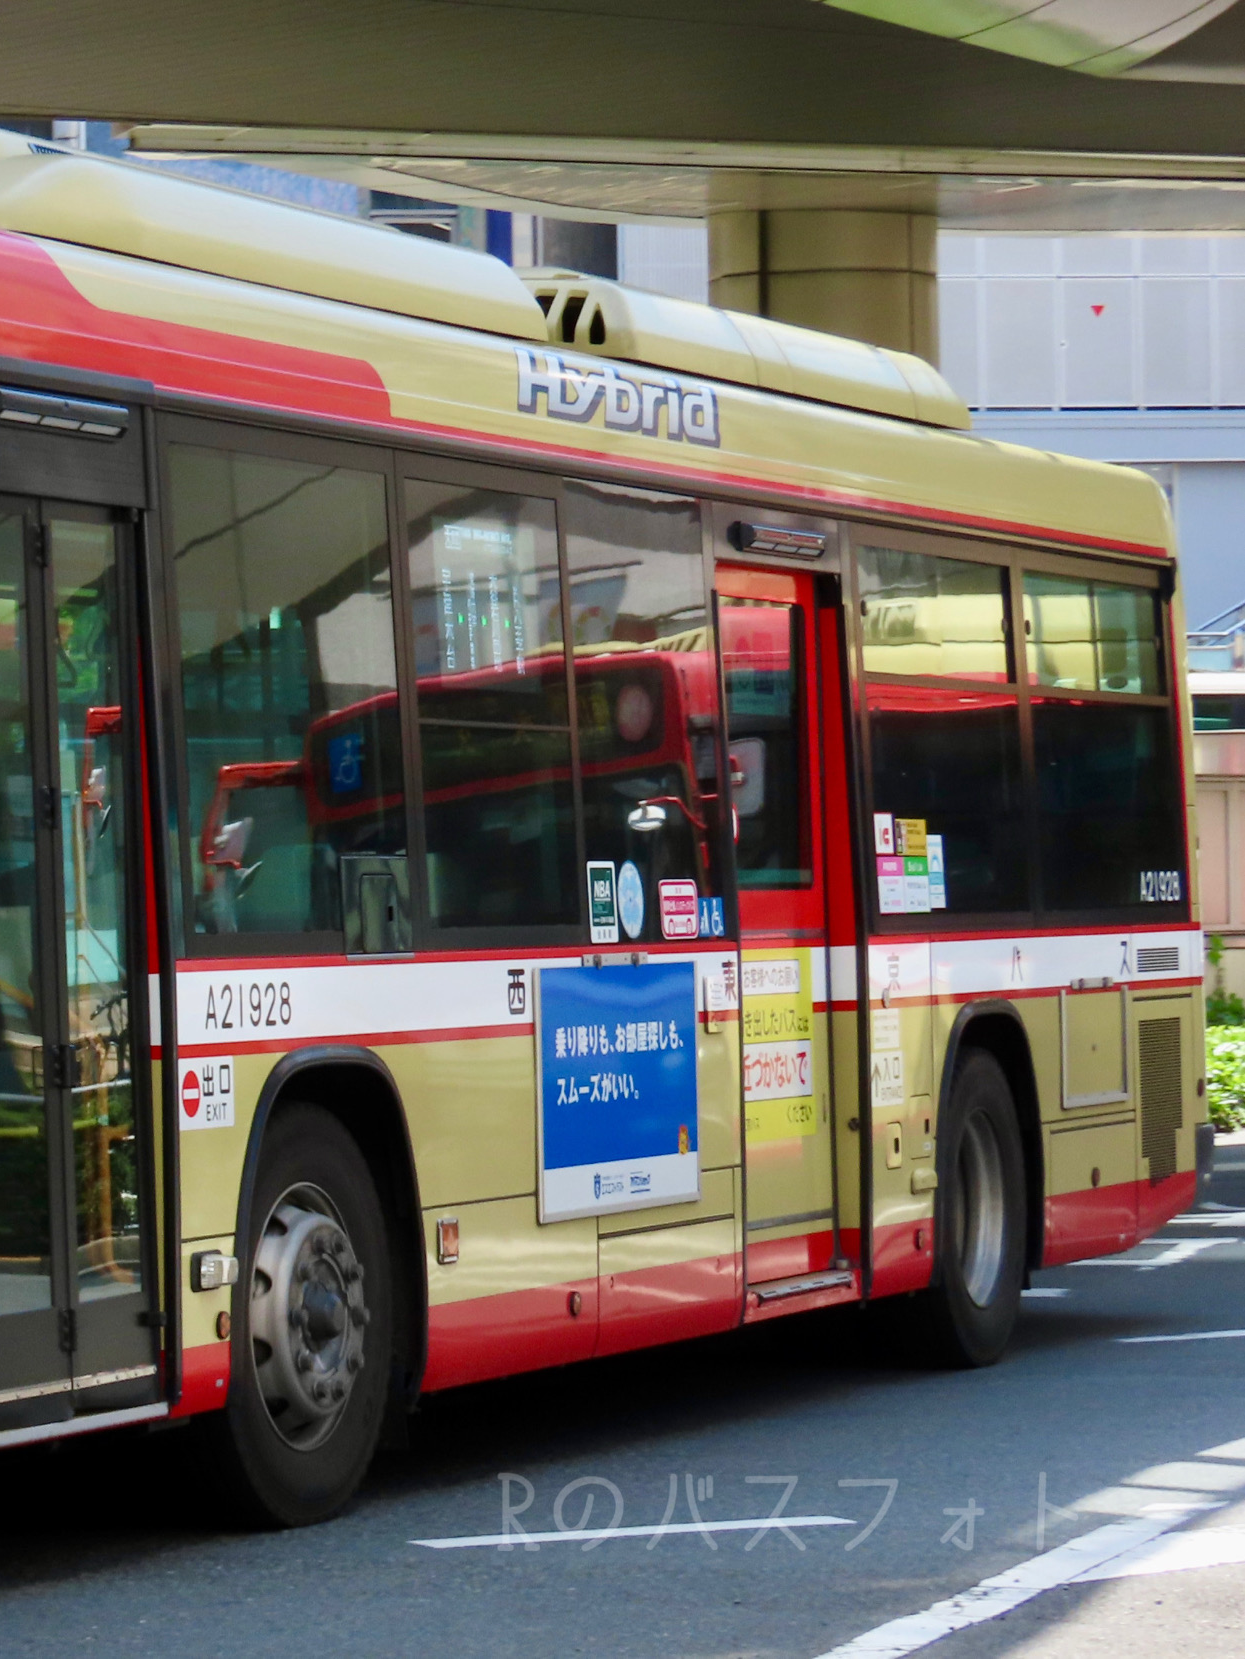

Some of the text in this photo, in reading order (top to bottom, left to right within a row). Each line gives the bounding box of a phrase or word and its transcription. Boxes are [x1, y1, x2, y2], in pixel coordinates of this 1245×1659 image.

[515, 346, 721, 449] Hybrid
[593, 880, 611, 898] NBA
[1139, 870, 1181, 902] A21928
[204, 981, 293, 1030] A21928
[201, 1063, 232, 1099] 出口
[556, 1072, 640, 1106] スムーズがいい。
[205, 1102, 228, 1122] EXIT
